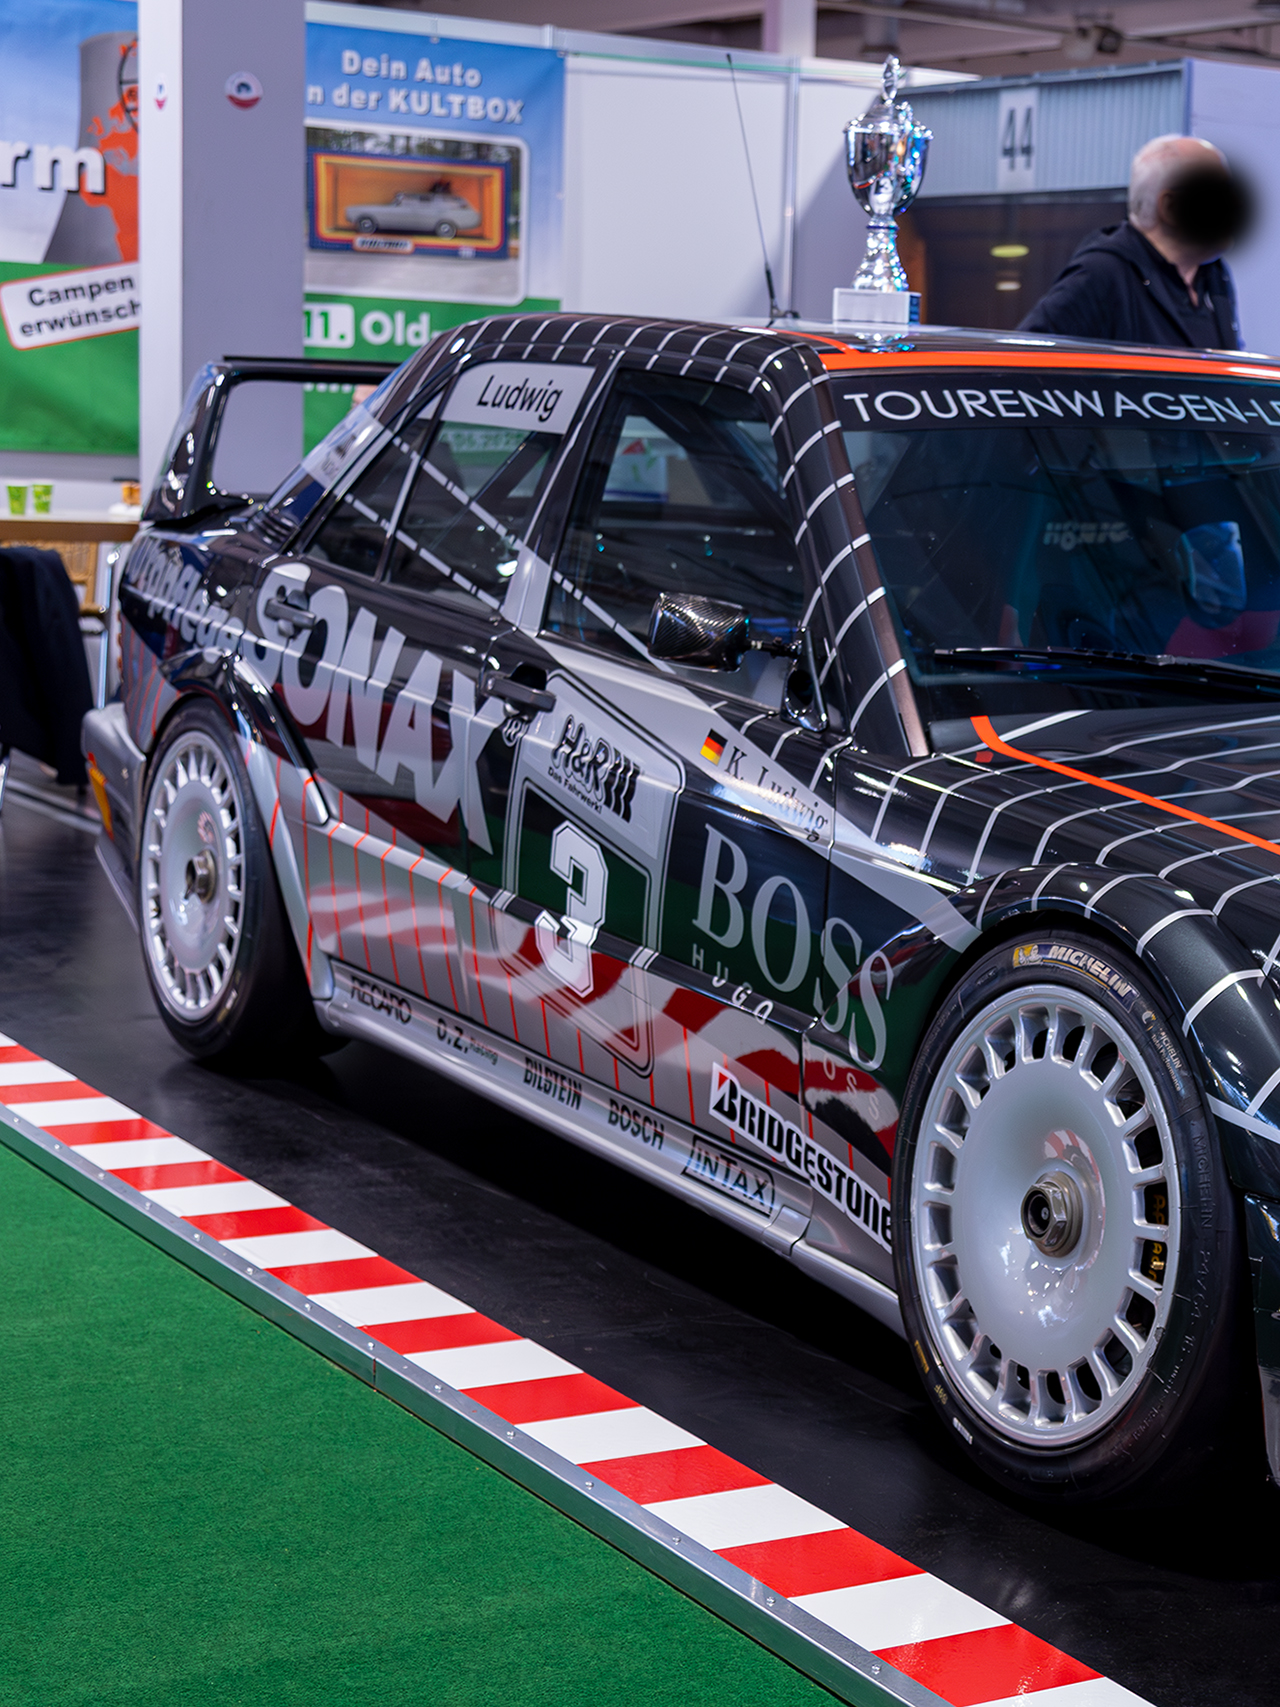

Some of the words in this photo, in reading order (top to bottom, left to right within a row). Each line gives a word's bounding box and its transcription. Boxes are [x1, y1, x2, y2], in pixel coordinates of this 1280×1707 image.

[341, 49, 408, 81] Dein
[414, 57, 483, 89] Auto
[332, 83, 382, 111] der
[389, 87, 525, 125] KULTBOX
[1002, 107, 1034, 171] 44
[28, 275, 135, 307] Campen
[477, 374, 563, 422] Ludwig
[256, 561, 506, 855] SONAX
[551, 713, 613, 803] H&R
[725, 746, 747, 781] K.
[534, 820, 610, 998] 3
[692, 823, 896, 1072] BOSS
[1048, 945, 1132, 998] MICHELIN
[350, 975, 412, 1025] RECARO
[691, 943, 774, 1025] HUGO
[523, 1056, 583, 1111] BILSTEIN
[608, 1098, 665, 1151] BOSCH
[691, 1146, 770, 1207] INTAX
